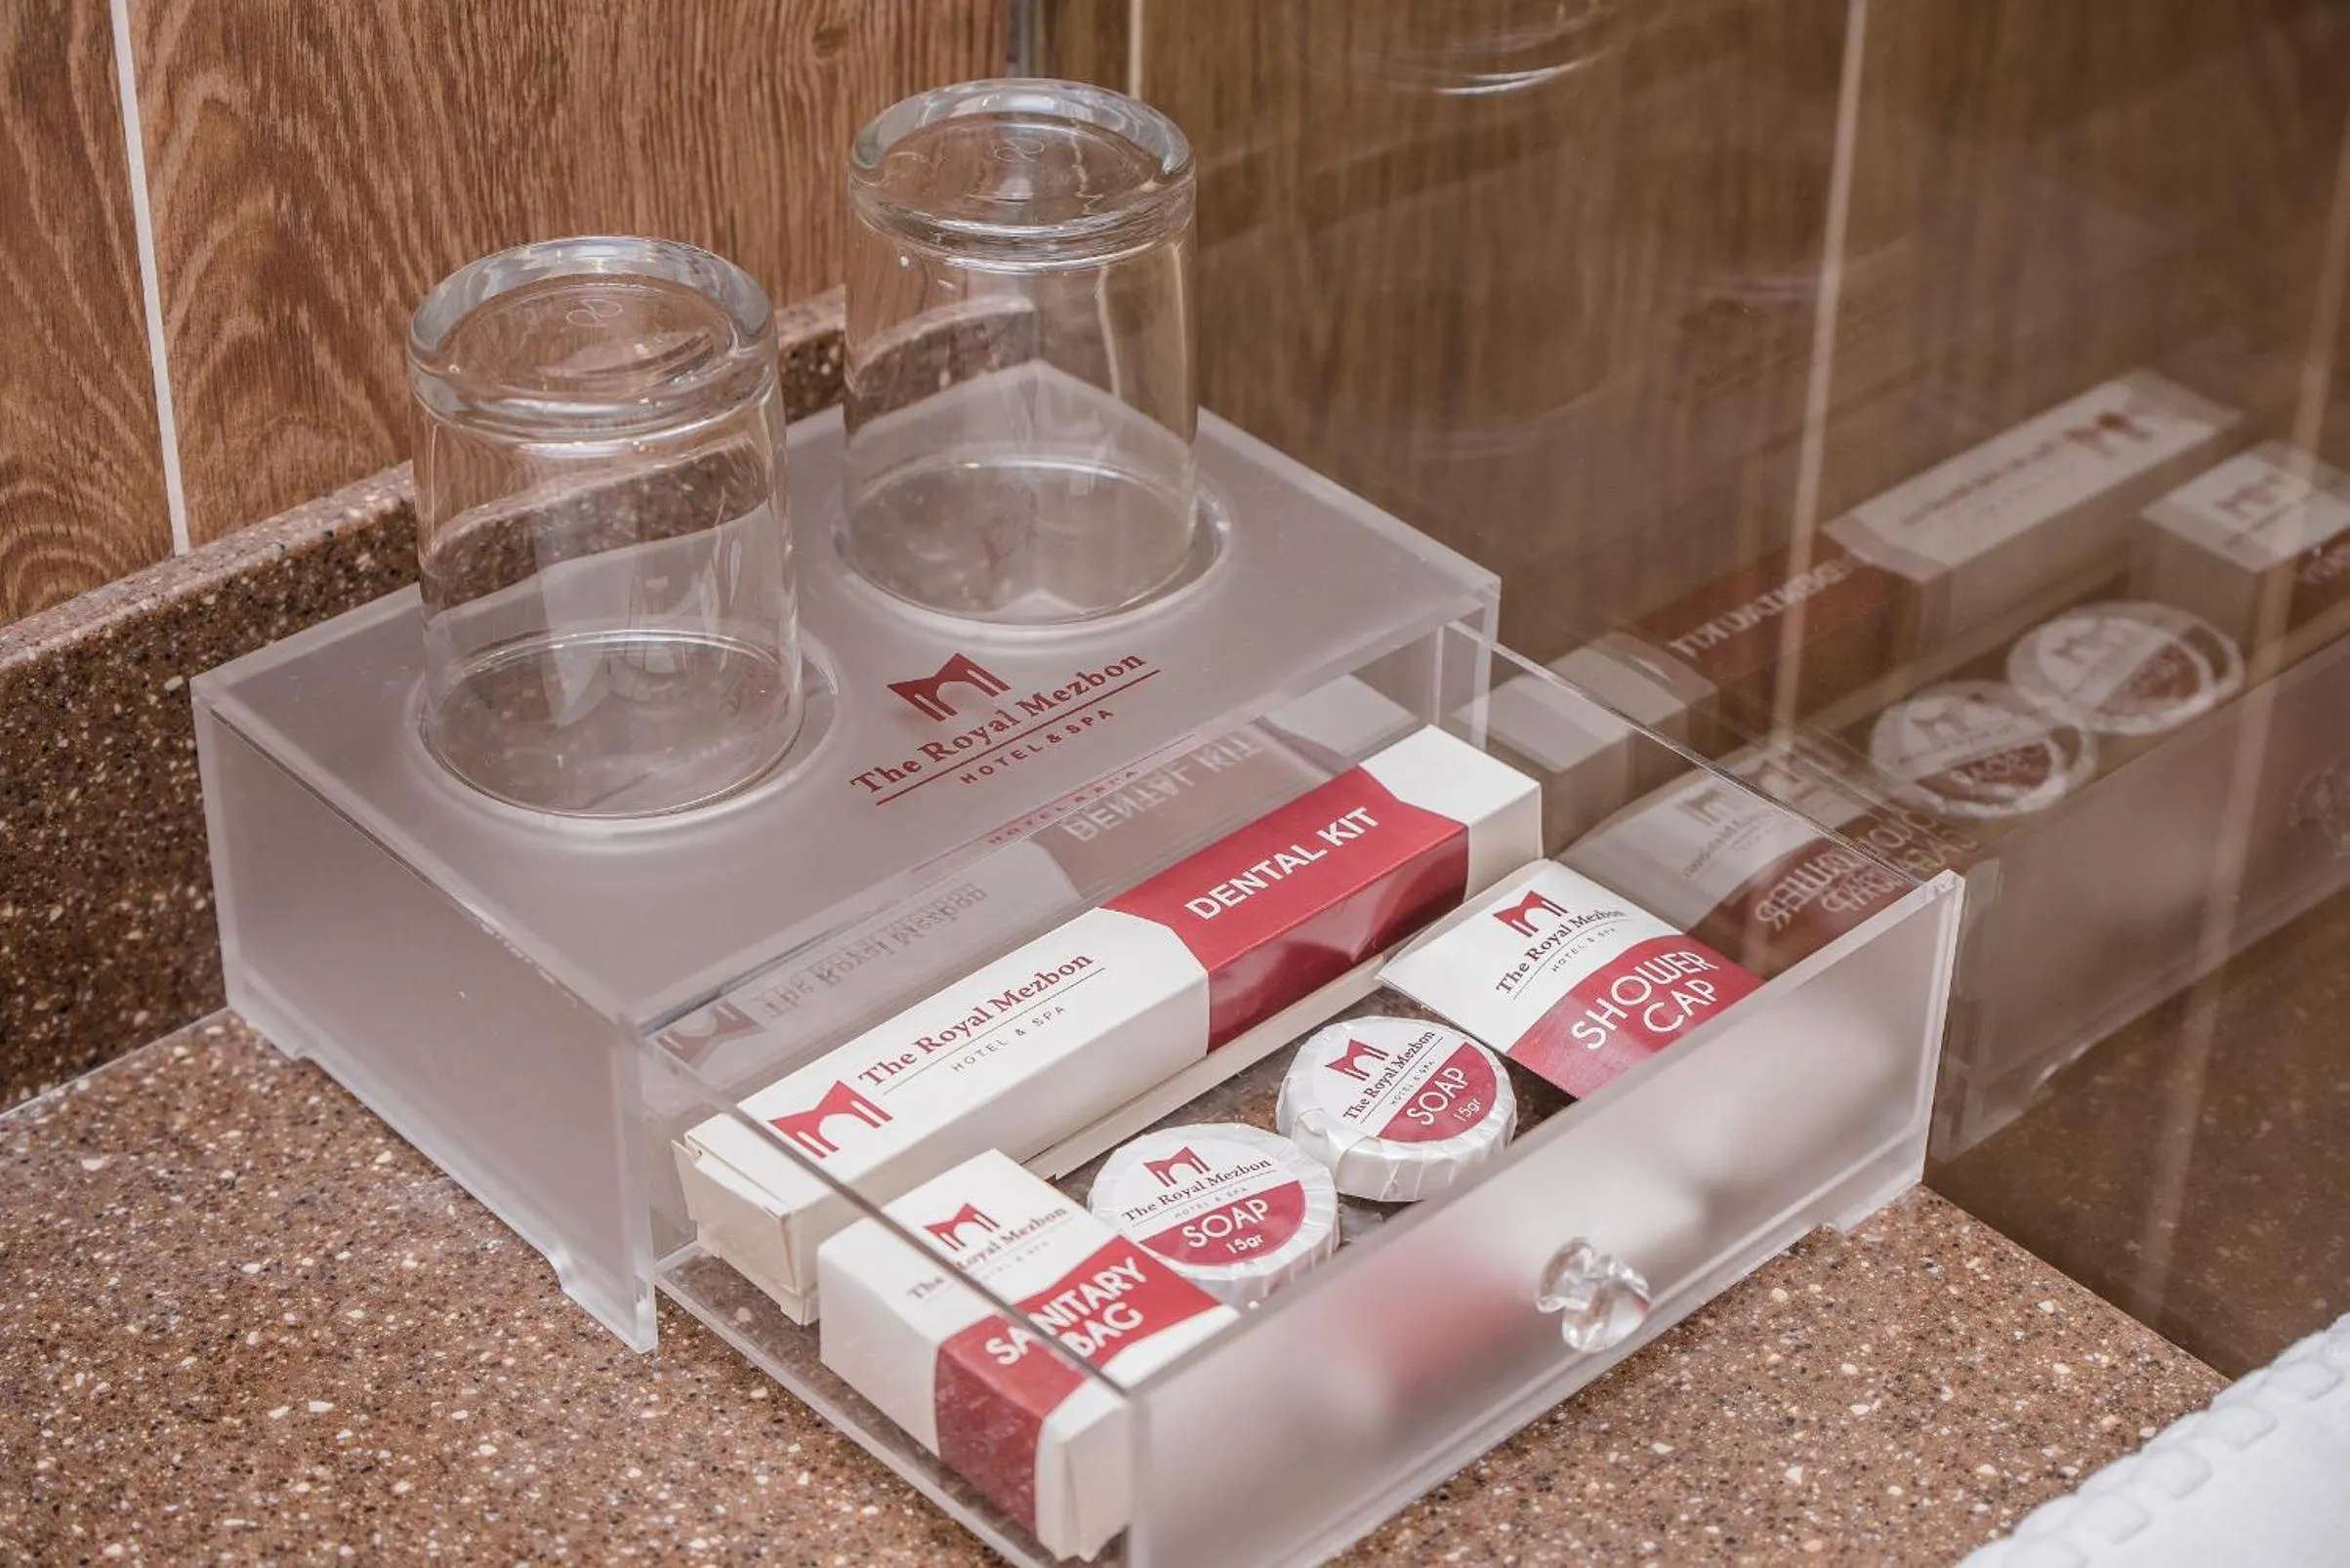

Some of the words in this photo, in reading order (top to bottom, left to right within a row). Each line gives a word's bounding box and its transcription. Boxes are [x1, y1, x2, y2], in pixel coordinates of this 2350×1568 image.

[849, 758, 923, 794] The
[917, 709, 1021, 763] Royal
[1015, 653, 1146, 718] Mezbon
[960, 743, 1044, 784] HOTEL
[1065, 708, 1114, 734] SPA
[1184, 844, 1329, 921] DENTAL
[1316, 806, 1380, 846] KIT
[1496, 962, 1530, 993] The
[1524, 923, 1573, 962] Royal
[1568, 909, 1627, 928] Mezbon
[1550, 944, 1586, 972] HOTEL
[858, 1052, 918, 1086] The
[913, 1006, 995, 1054] Royal
[987, 954, 1094, 1012] Mezbon
[1571, 951, 1719, 1050] SHOWER
[1643, 979, 1717, 1032] CAP
[952, 1037, 1010, 1072] HOTEL
[1014, 1027, 1027, 1038] &
[1032, 1005, 1067, 1027] SPA
[1342, 1096, 1368, 1122] The
[1366, 1065, 1399, 1101] Royal
[1393, 1030, 1436, 1070] Mezbon
[1406, 1066, 1469, 1125] SOAP
[1453, 1097, 1482, 1123] 15gr
[1122, 1202, 1157, 1221] The
[1159, 1179, 1207, 1207] Royal
[1207, 1158, 1271, 1188] Mezbon
[1181, 1198, 1269, 1249] SOAP
[906, 1276, 945, 1300] The
[1000, 1206, 1069, 1245] Mezbon
[1225, 1233, 1264, 1255] 15gr
[984, 1256, 1147, 1366] SANITARY
[1059, 1300, 1145, 1359] BAG
